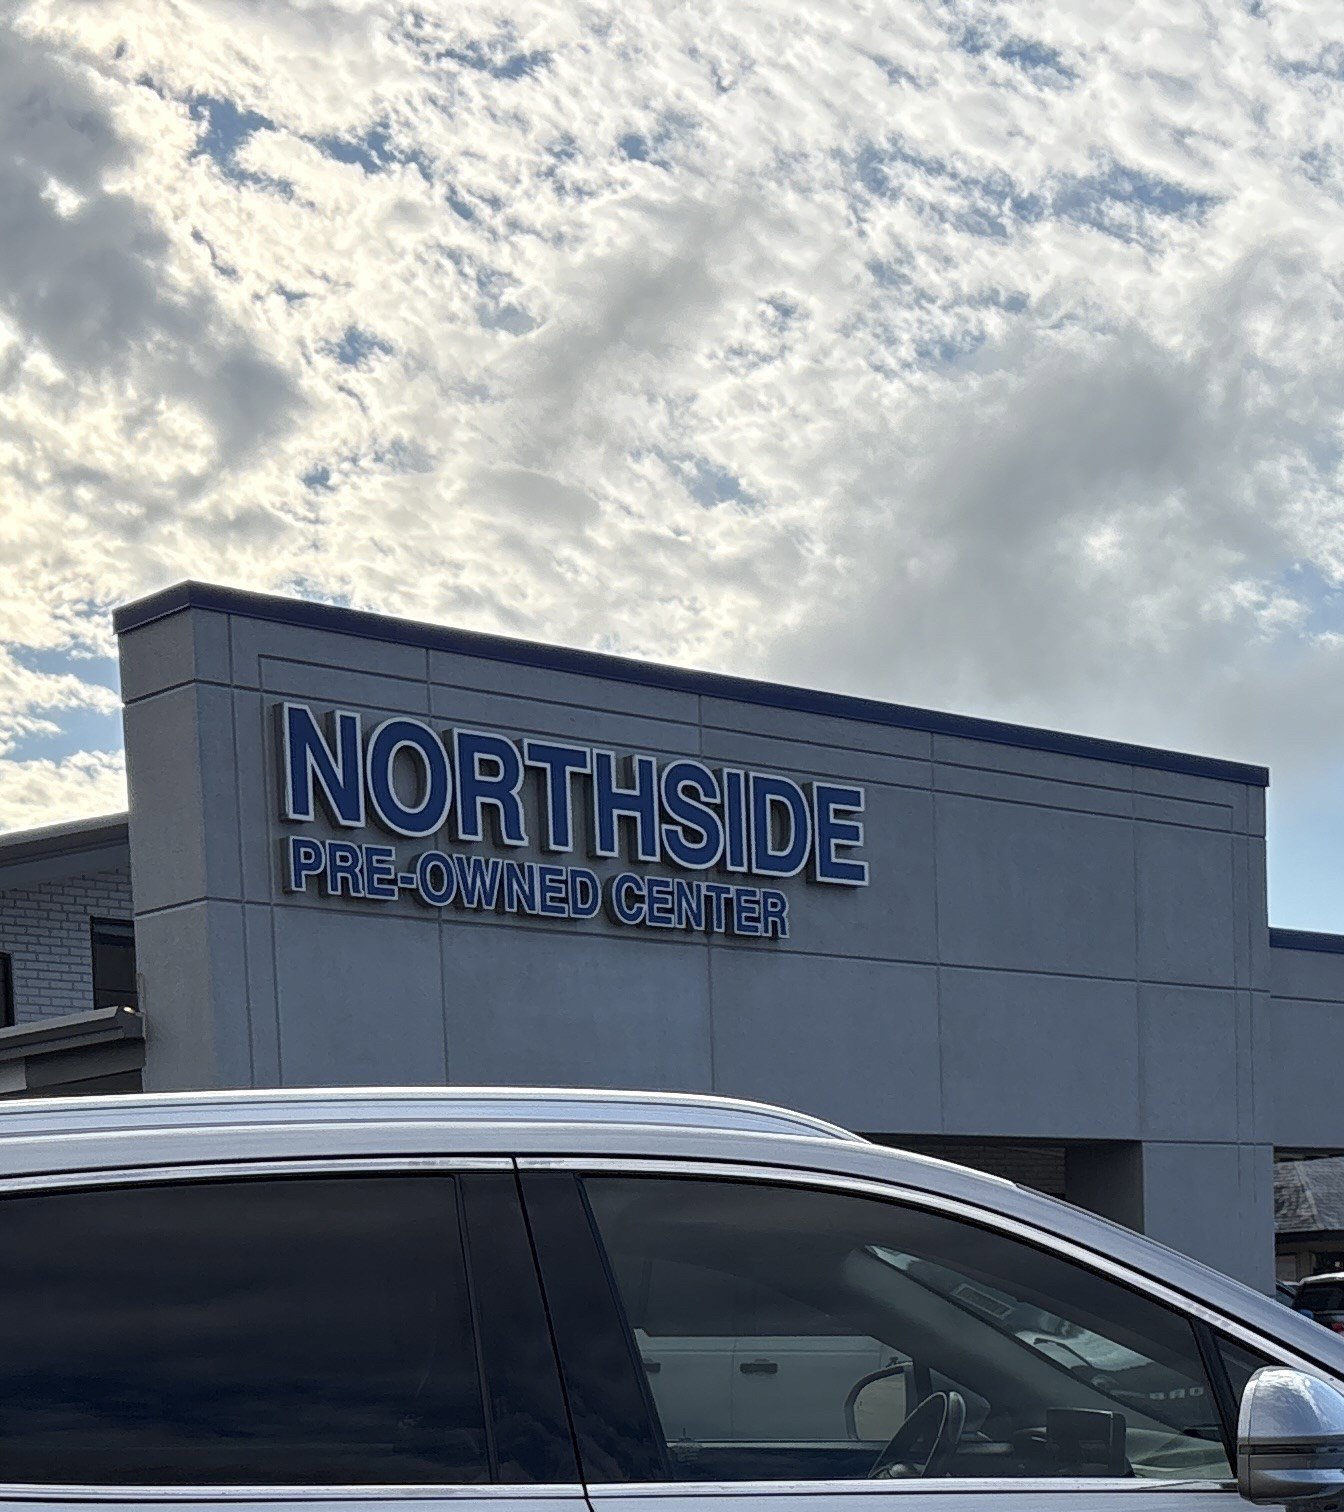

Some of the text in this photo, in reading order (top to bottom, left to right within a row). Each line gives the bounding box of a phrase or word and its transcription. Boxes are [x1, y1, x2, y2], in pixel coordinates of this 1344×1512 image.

[276, 702, 869, 886] NORTHSIDE
[286, 836, 790, 938] PRE-OWNED CENTER
